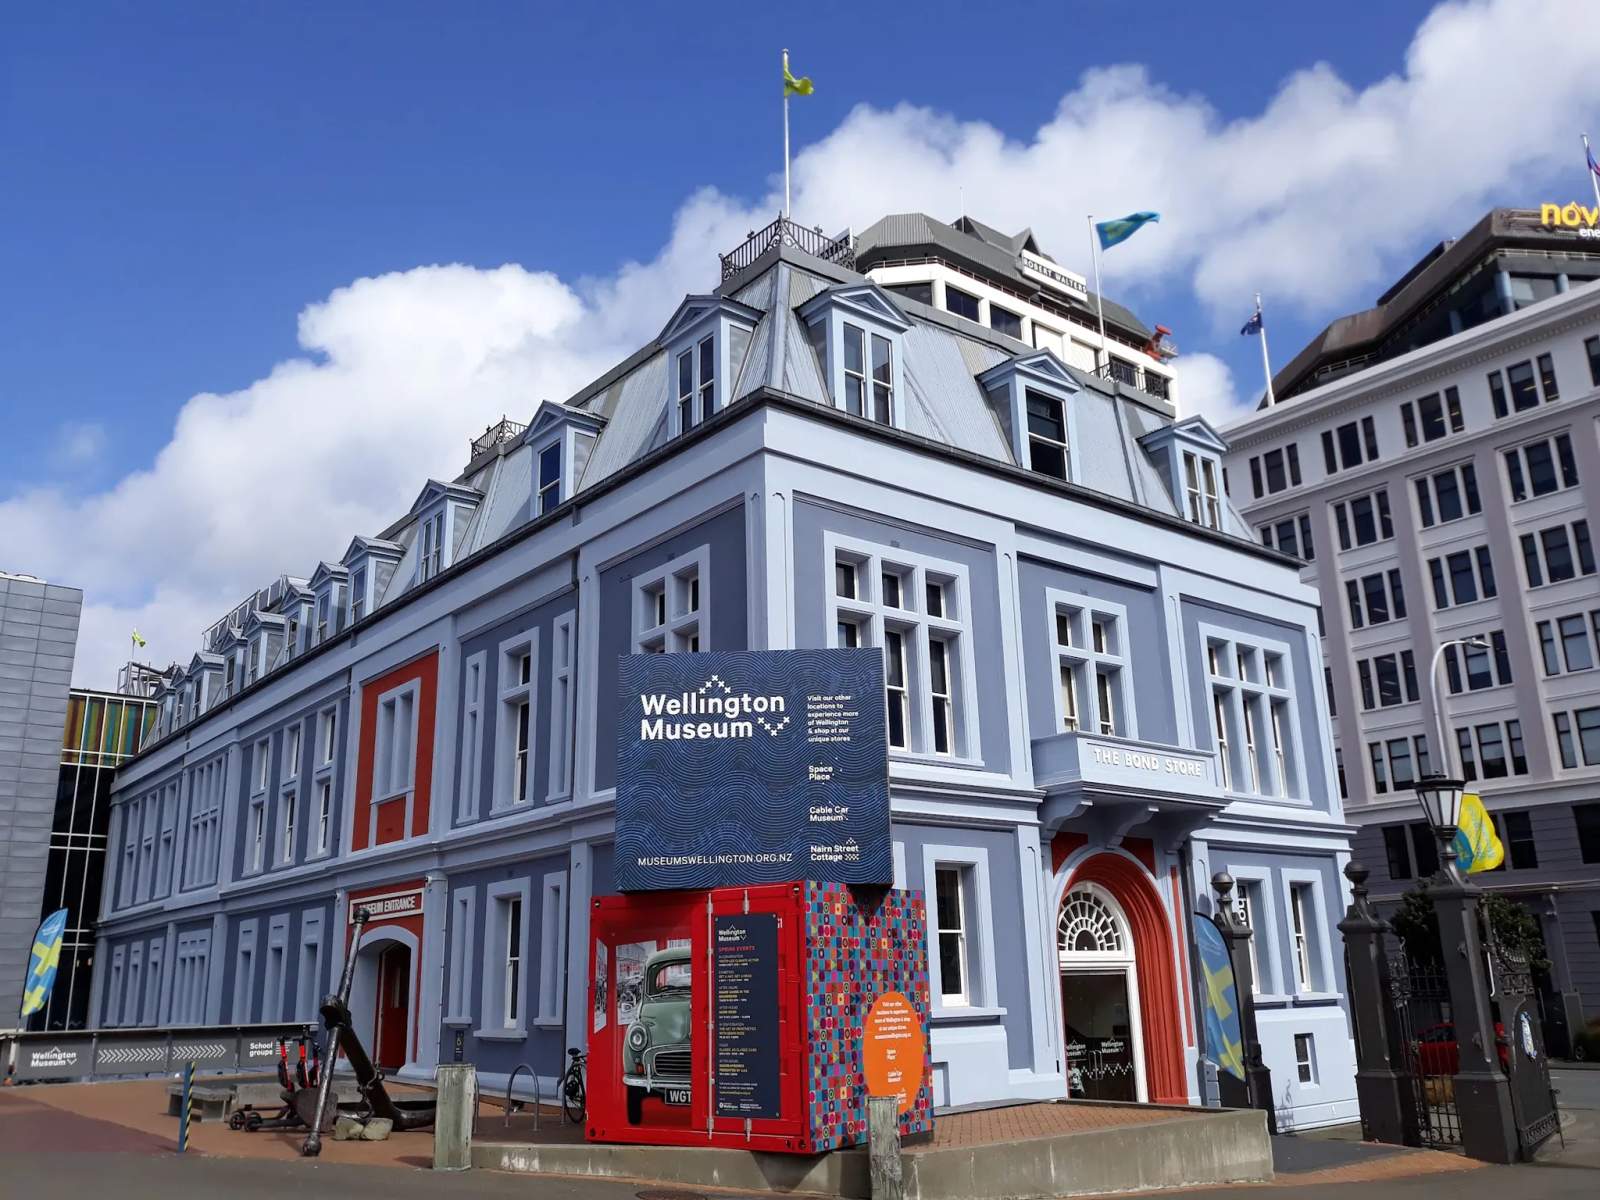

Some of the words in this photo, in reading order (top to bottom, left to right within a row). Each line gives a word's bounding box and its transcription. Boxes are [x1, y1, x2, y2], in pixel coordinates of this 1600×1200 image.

[1023, 257, 1052, 277] ROBERT
[640, 692, 785, 718] Wellington
[641, 718, 753, 740] Museum
[1094, 748, 1119, 765] THE
[1125, 753, 1159, 771] BOND
[1165, 759, 1201, 777] STORE
[808, 765, 833, 773] Space
[809, 806, 833, 814] Cable
[834, 806, 849, 814] Car
[810, 845, 833, 853] Nairn
[833, 844, 859, 852] Street
[638, 853, 793, 866] MUSEUMSWELLINGTON.ORG.NZ
[810, 853, 843, 862] Cottage
[384, 895, 416, 912] ENTRANCE
[250, 1041, 273, 1050] School
[32, 1051, 77, 1060] Wellington
[31, 1059, 66, 1067] Museum
